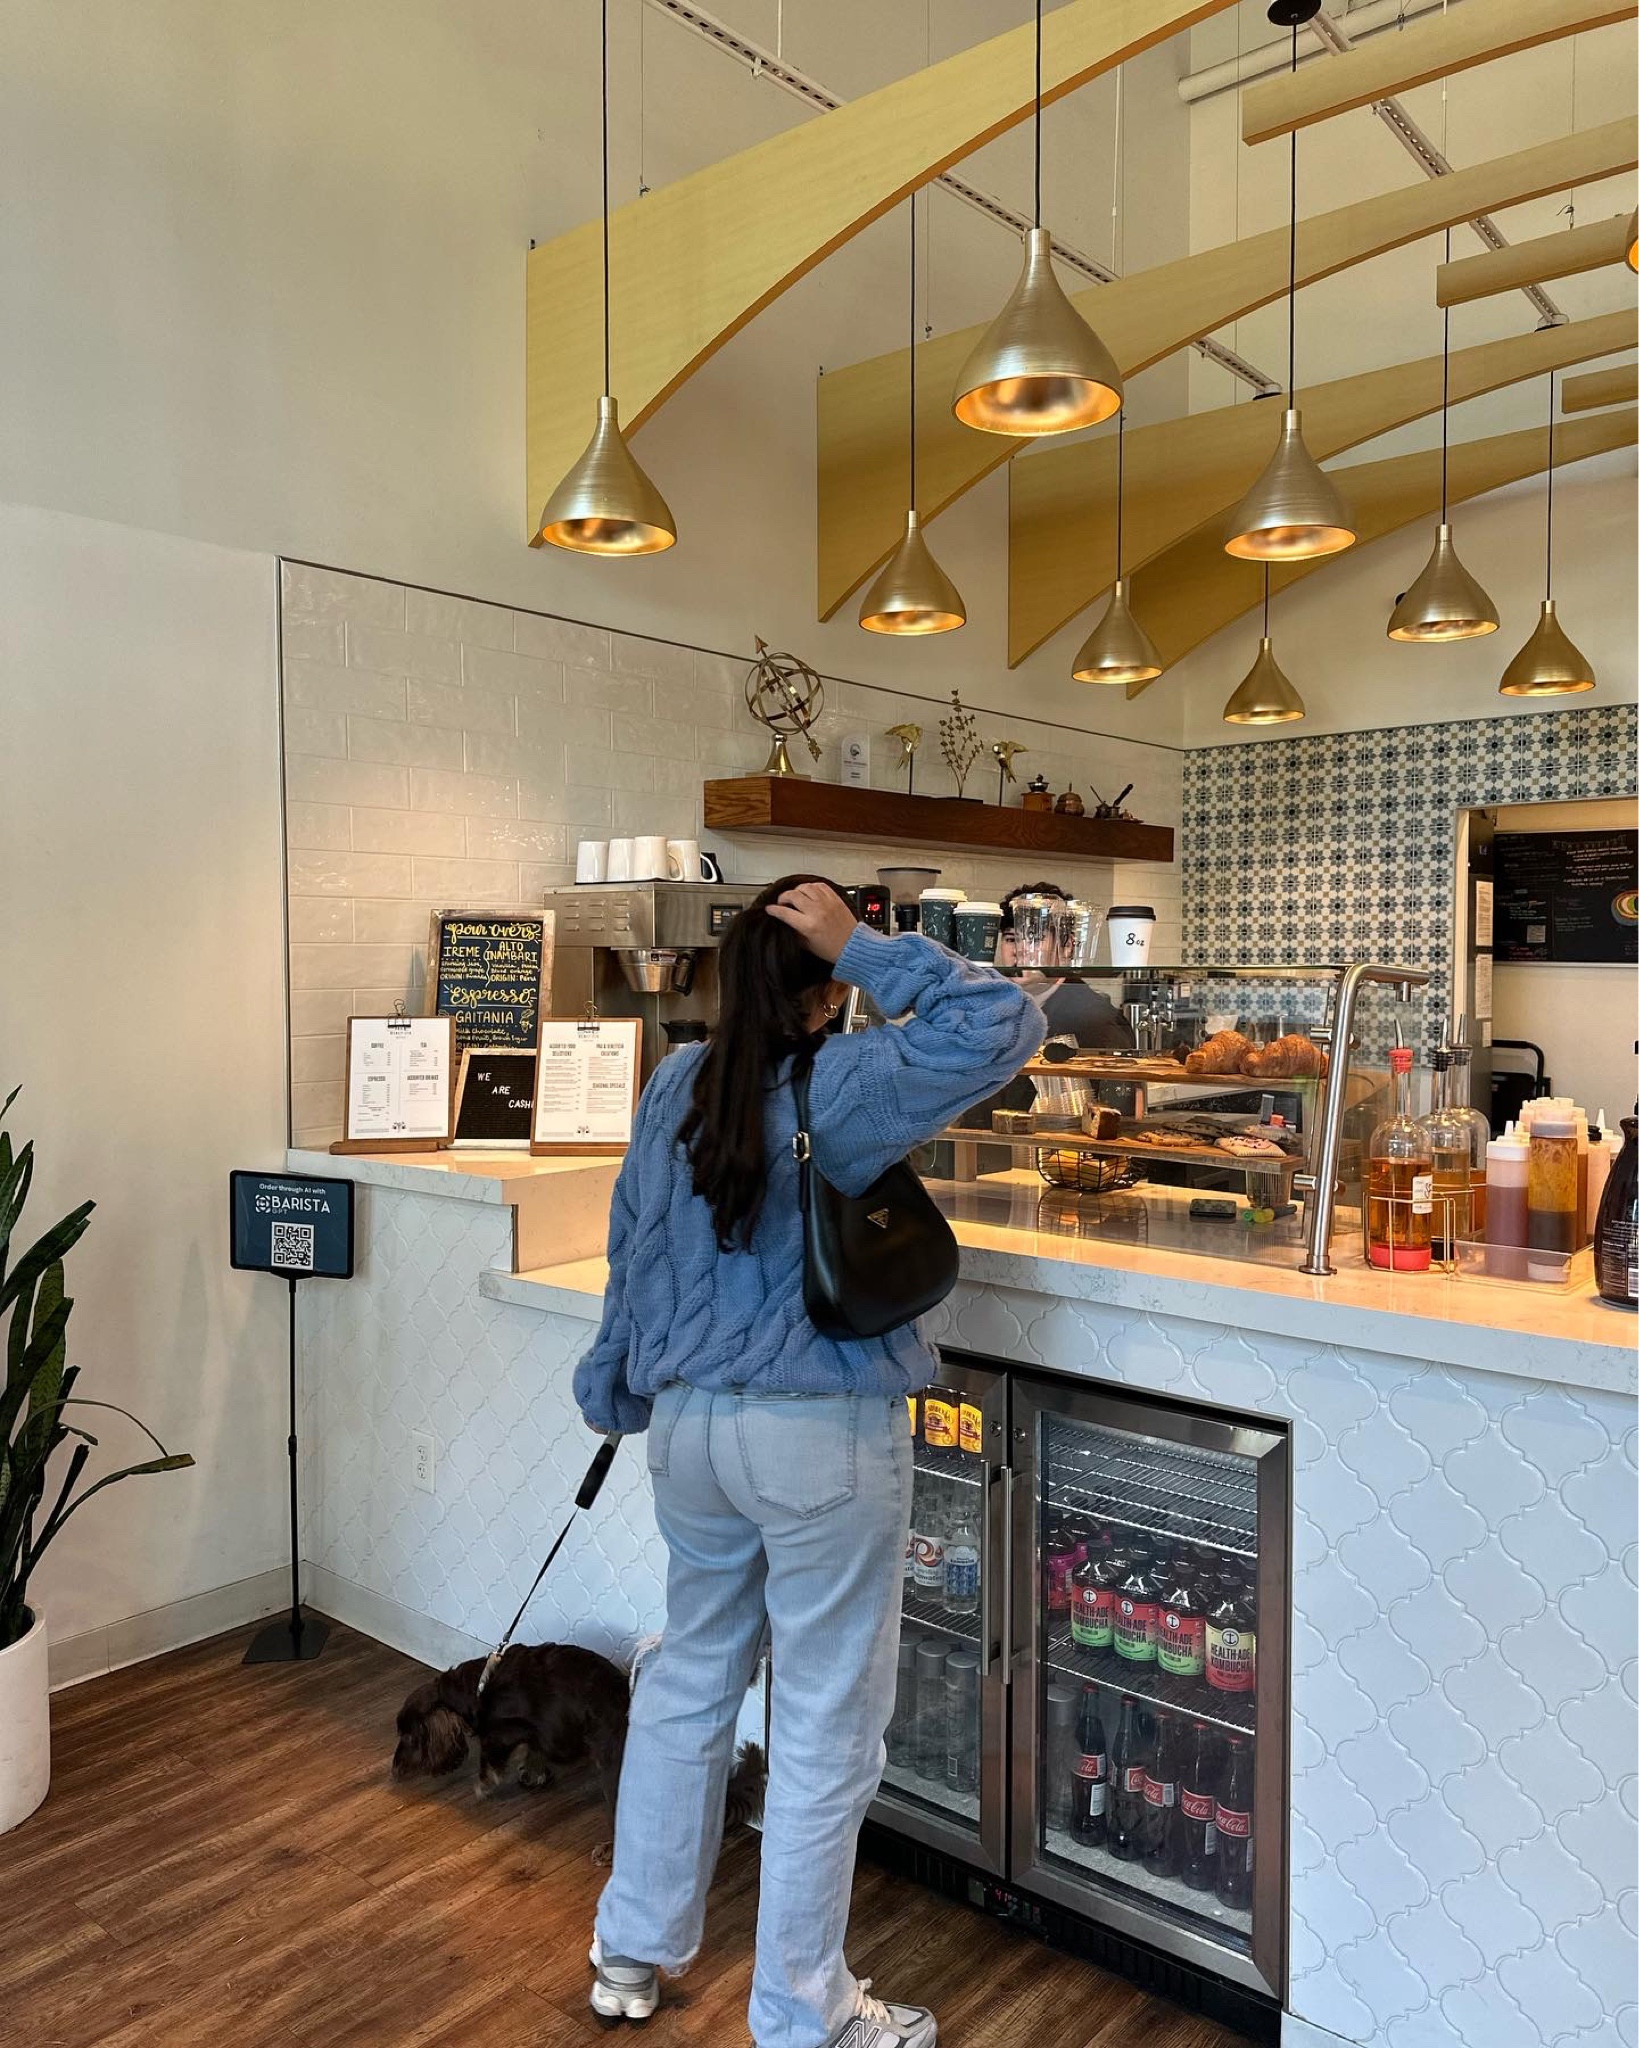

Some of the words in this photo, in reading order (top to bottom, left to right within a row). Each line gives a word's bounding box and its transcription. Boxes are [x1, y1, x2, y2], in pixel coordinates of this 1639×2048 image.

[499, 941, 524, 951] ALTO
[443, 946, 480, 957] IREME
[486, 951, 538, 961] INAMBARI
[456, 1010, 514, 1024] GAITANIA
[477, 1072, 493, 1082] WE
[491, 1086, 511, 1095] ARE
[278, 1184, 303, 1193] through
[271, 1195, 331, 1214] BARISTA
